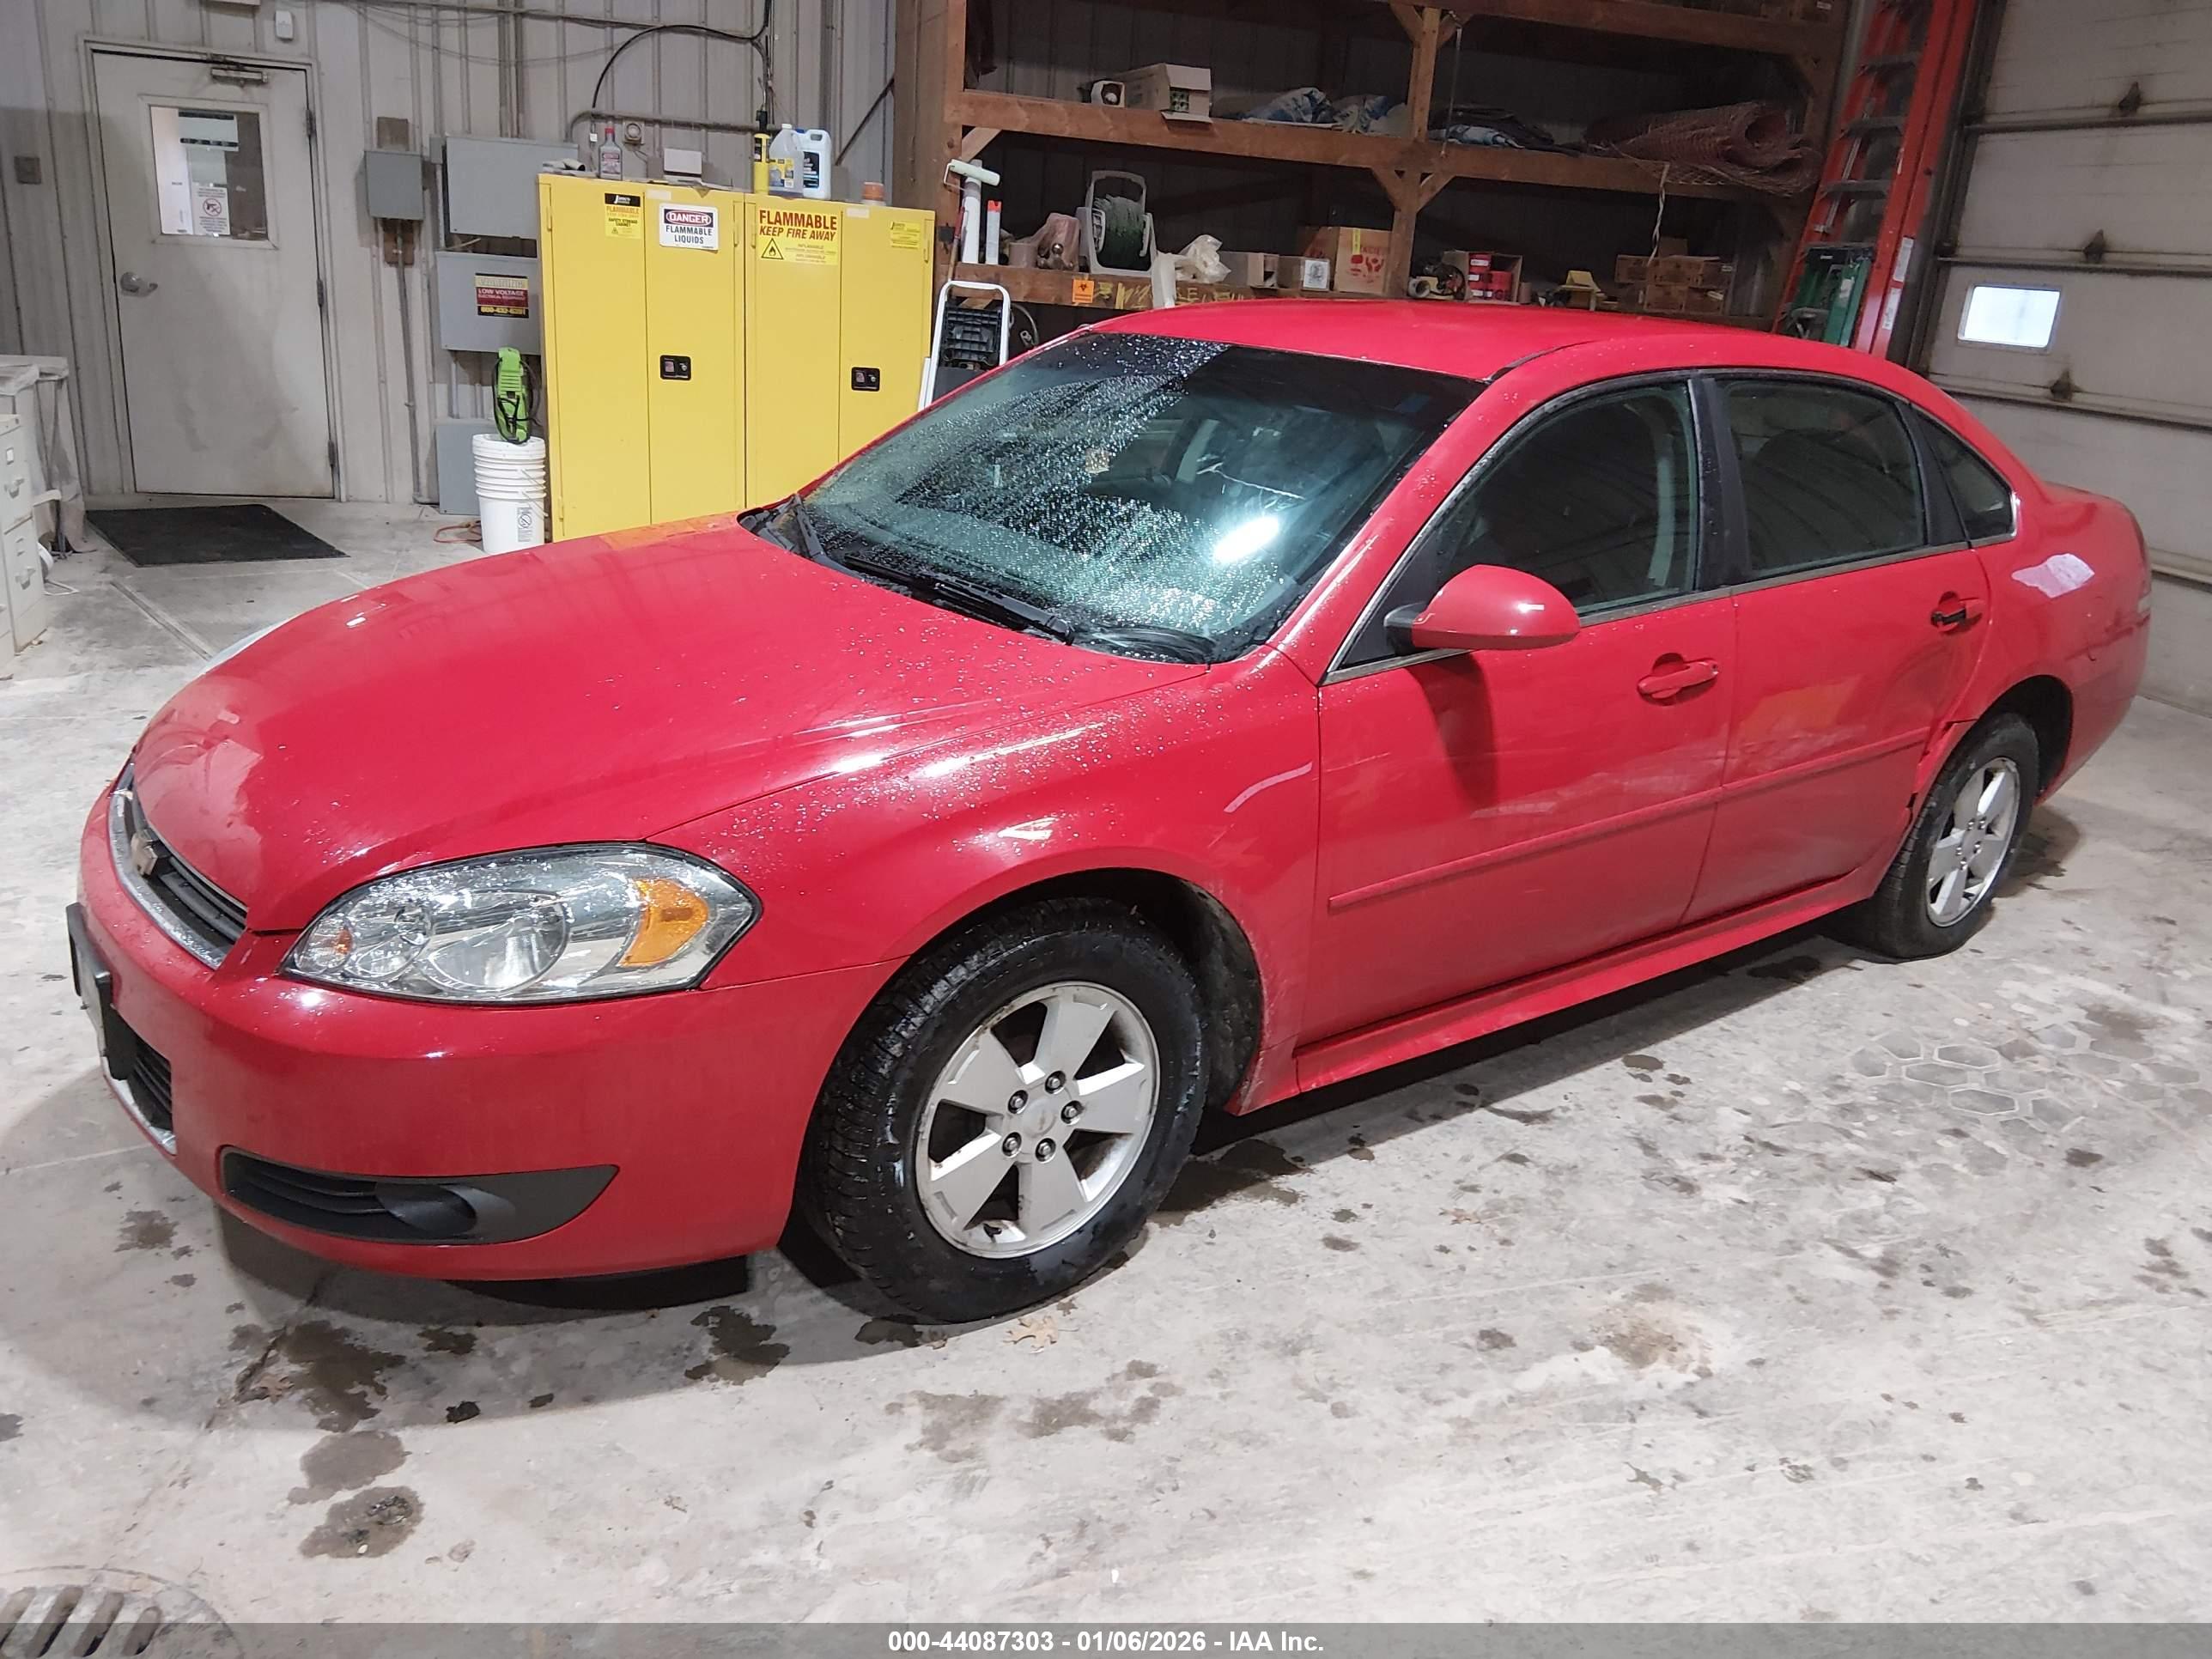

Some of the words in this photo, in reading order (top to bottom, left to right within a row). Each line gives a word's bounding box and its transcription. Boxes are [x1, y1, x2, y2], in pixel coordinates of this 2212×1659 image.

[670, 212, 708, 224] DANGER
[759, 210, 837, 230] FLAMMABLE
[665, 225, 713, 236] FLAMMABLE
[760, 226, 784, 236] KEEP
[787, 228, 807, 239] FIRE
[810, 230, 836, 241] AWAY
[674, 234, 704, 245] LIQUIDS
